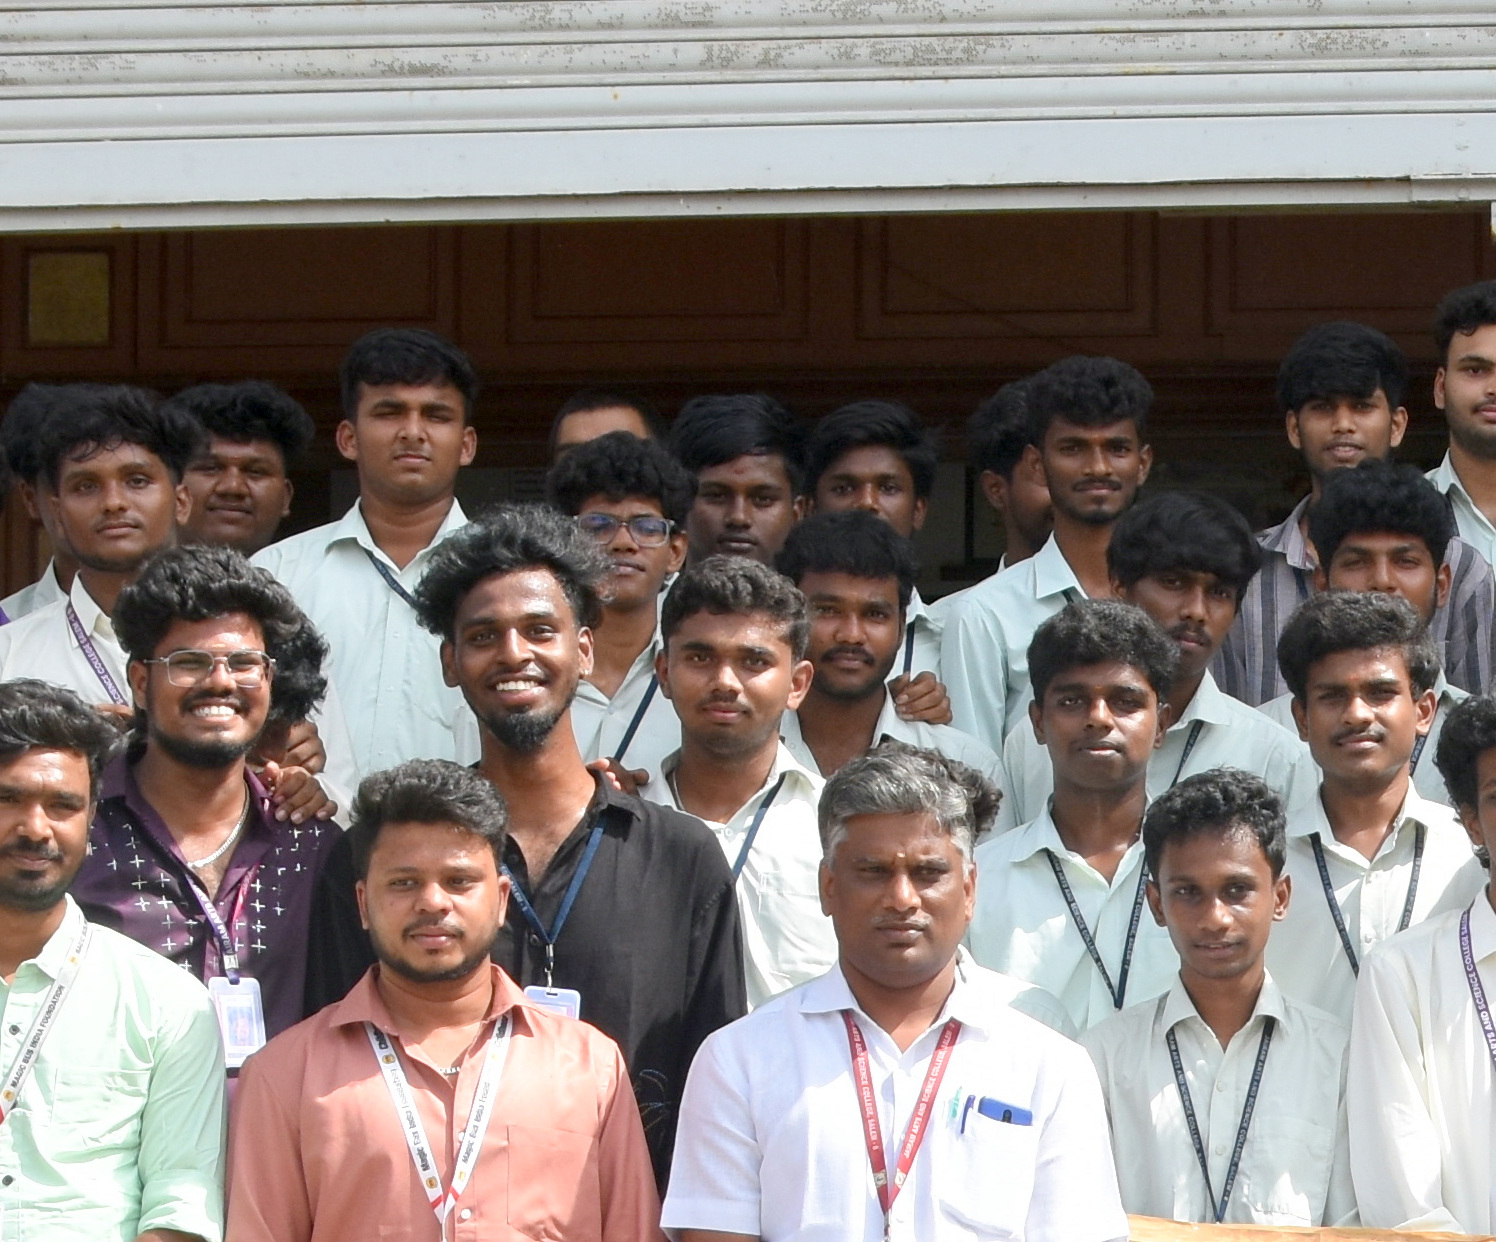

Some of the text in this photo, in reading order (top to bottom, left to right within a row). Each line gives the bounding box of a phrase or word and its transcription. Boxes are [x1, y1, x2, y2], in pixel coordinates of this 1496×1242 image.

[82, 641, 105, 675] COLLEGE
[1069, 902, 1086, 930] SCIENCE
[1460, 934, 1475, 971] COLLEGE
[1468, 971, 1487, 1010] SCIENCE
[9, 984, 65, 1088] MAGIC BUS INDIA FOUNDATION
[1480, 1010, 1493, 1031] AND
[1240, 1096, 1254, 1127] SCIENCE
